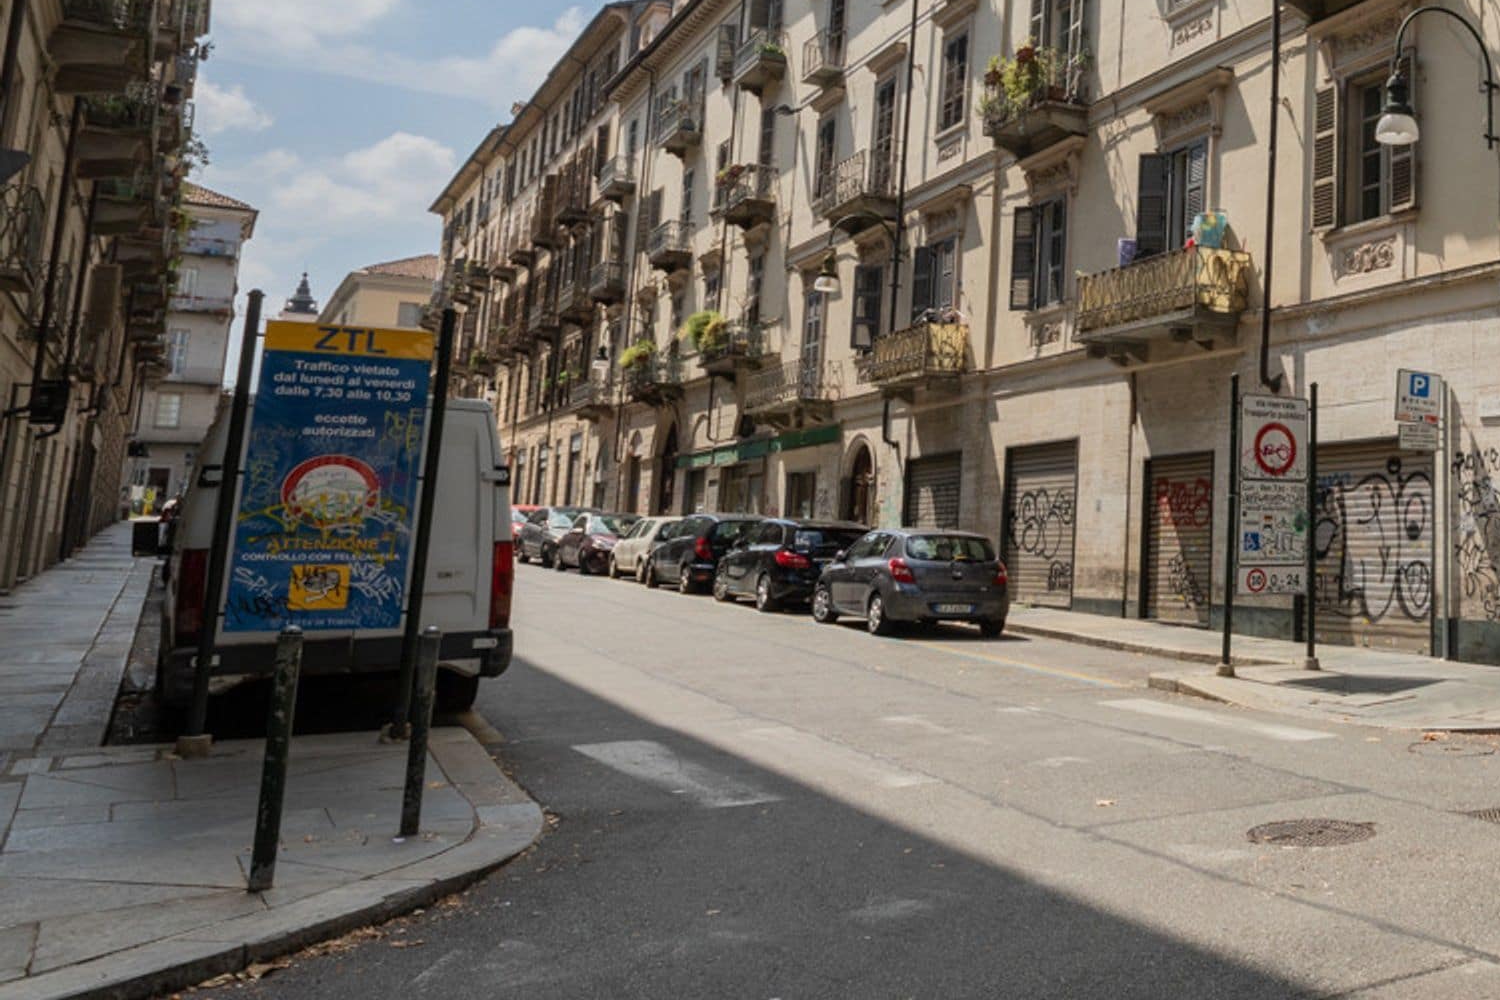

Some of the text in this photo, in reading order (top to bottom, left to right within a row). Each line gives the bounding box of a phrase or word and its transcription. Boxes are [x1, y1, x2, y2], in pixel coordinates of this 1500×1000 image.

[315, 327, 387, 353] ZTL
[295, 360, 399, 376] Traffico vietato
[273, 371, 297, 382] dal
[348, 376, 361, 387] al
[1414, 376, 1426, 395] P
[275, 385, 310, 397] dalle
[346, 389, 371, 400] alle
[314, 413, 368, 425] eccetto
[302, 427, 375, 438] autorizzati
[266, 536, 379, 552] ATTENZIONE
[242, 552, 400, 562] CONTROLLO CON TELECAA
